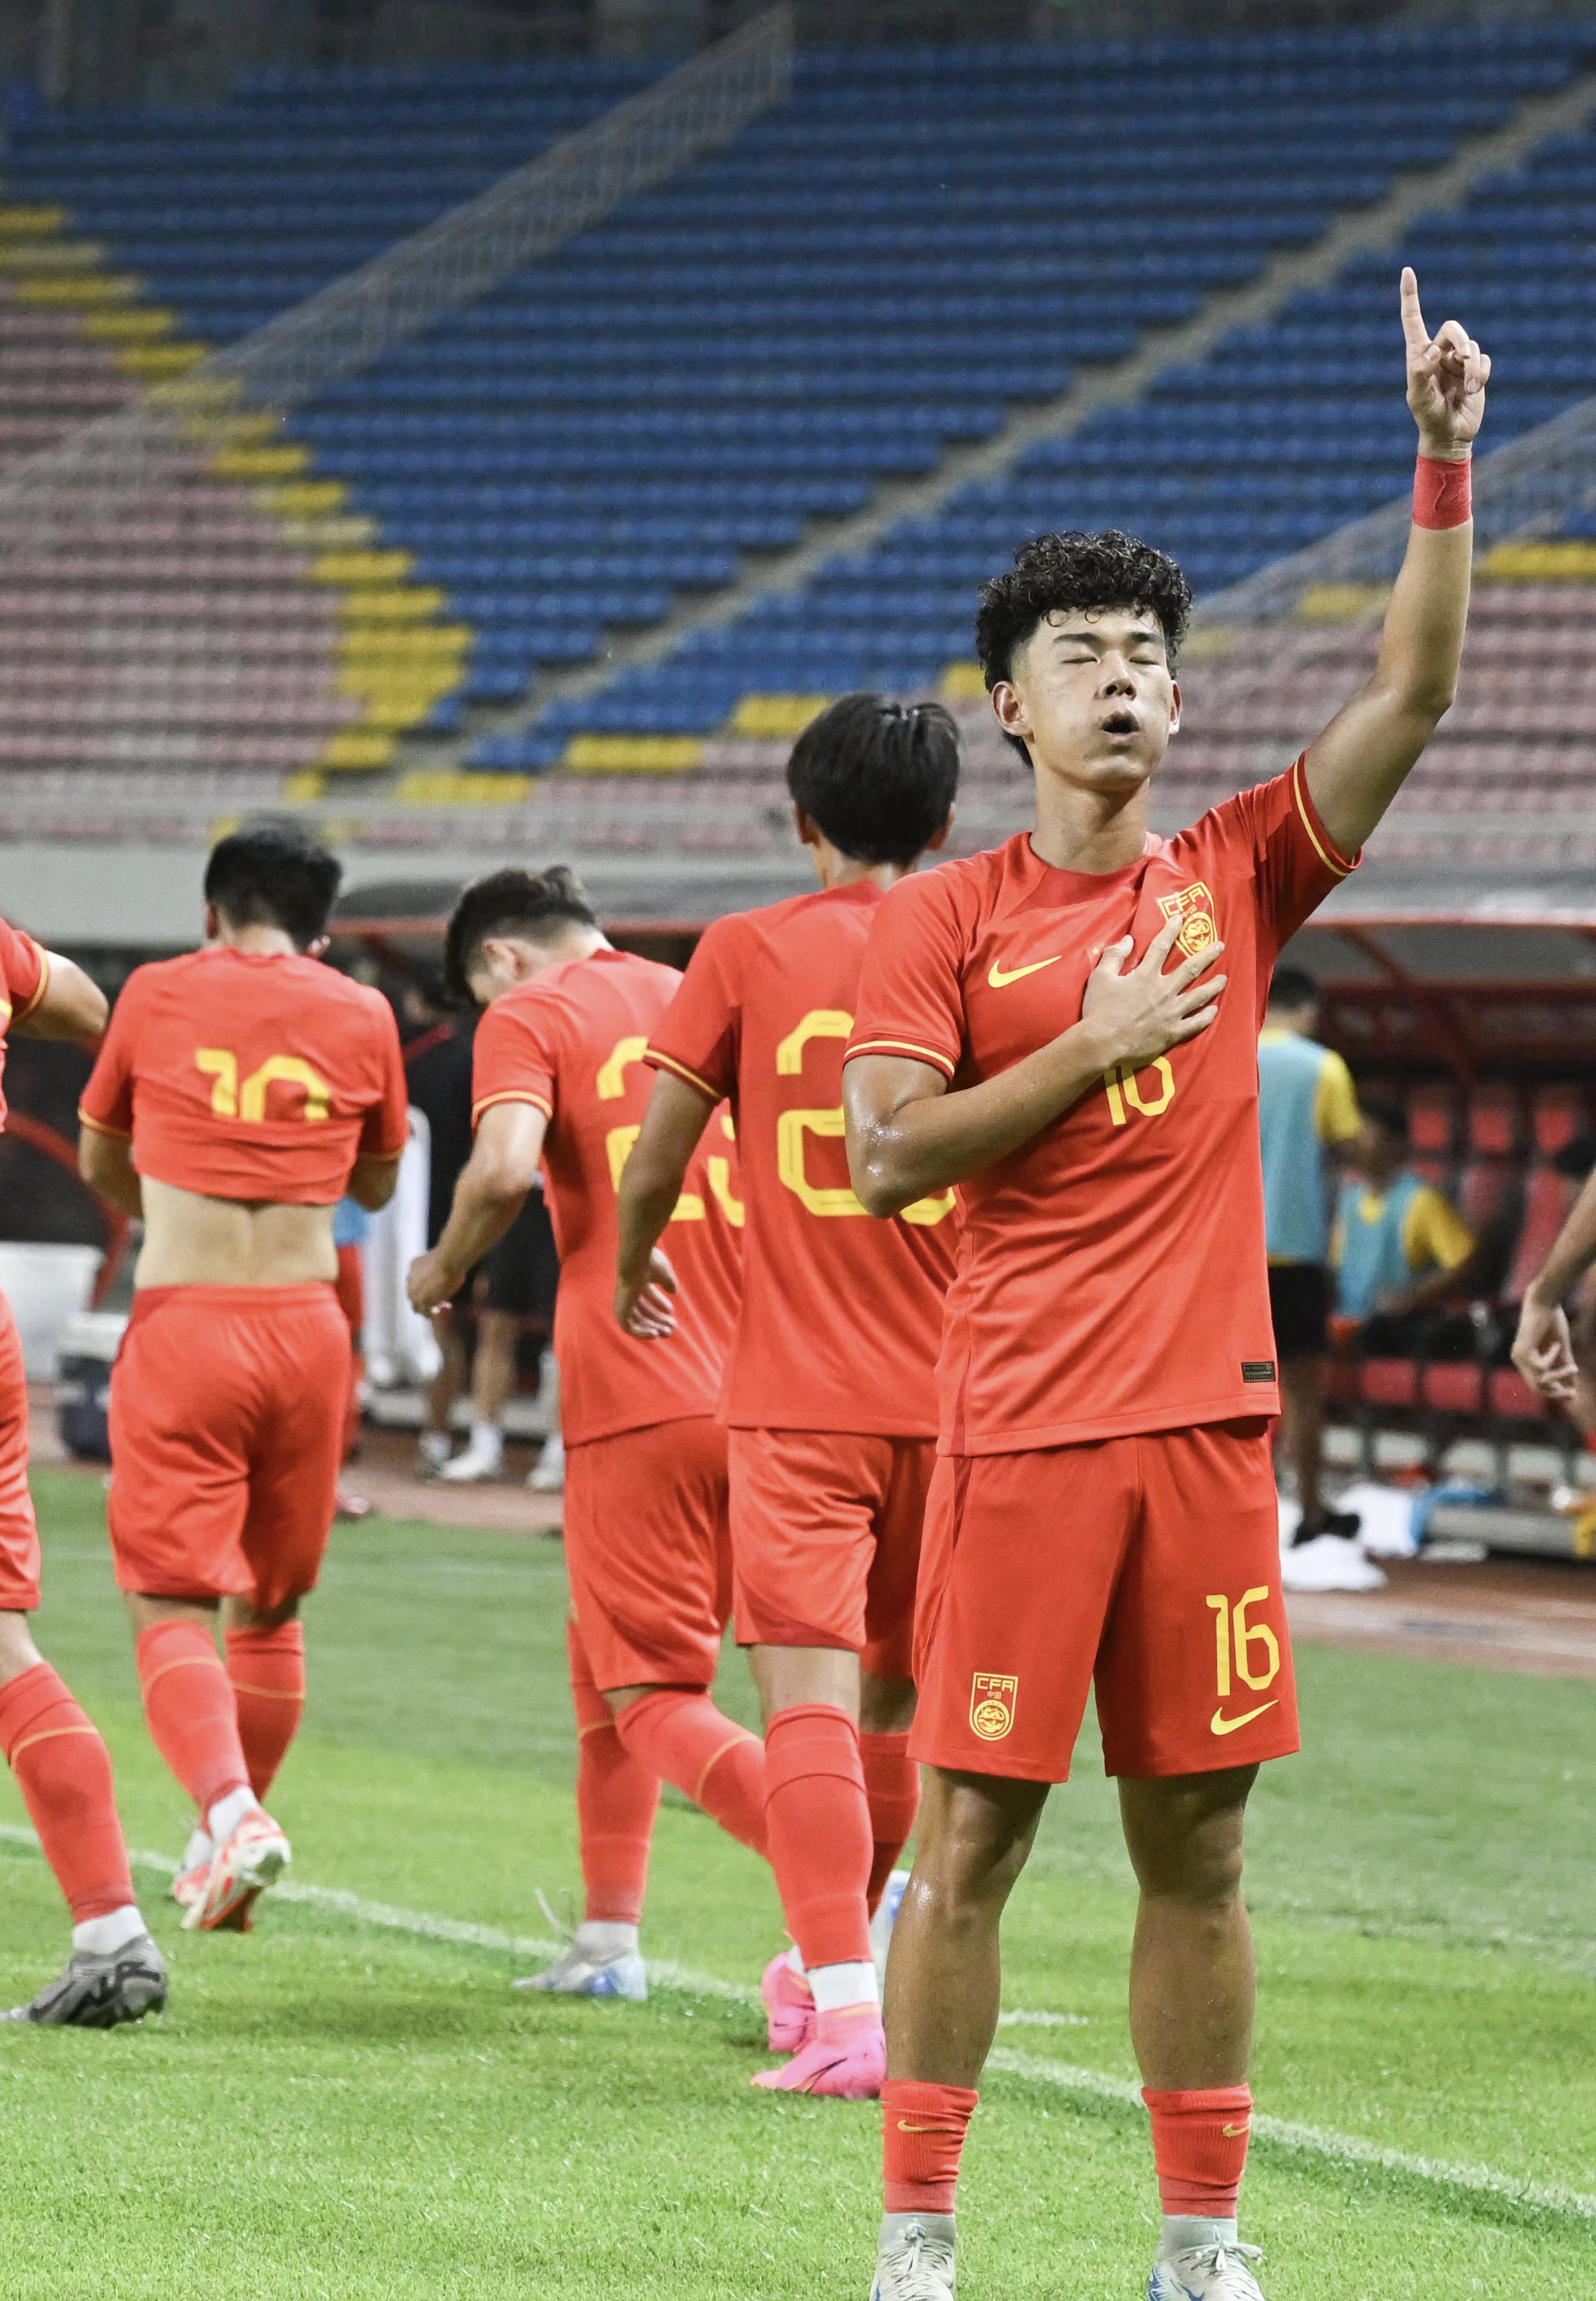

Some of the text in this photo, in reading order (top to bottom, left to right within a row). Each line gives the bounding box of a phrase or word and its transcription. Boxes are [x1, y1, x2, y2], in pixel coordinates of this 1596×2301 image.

[1164, 887, 1205, 916] CFA
[776, 1009, 957, 1226] 2
[1206, 1585, 1280, 1696] 16
[977, 1677, 1014, 1693] CFA
[987, 1691, 1002, 1700] 中国
